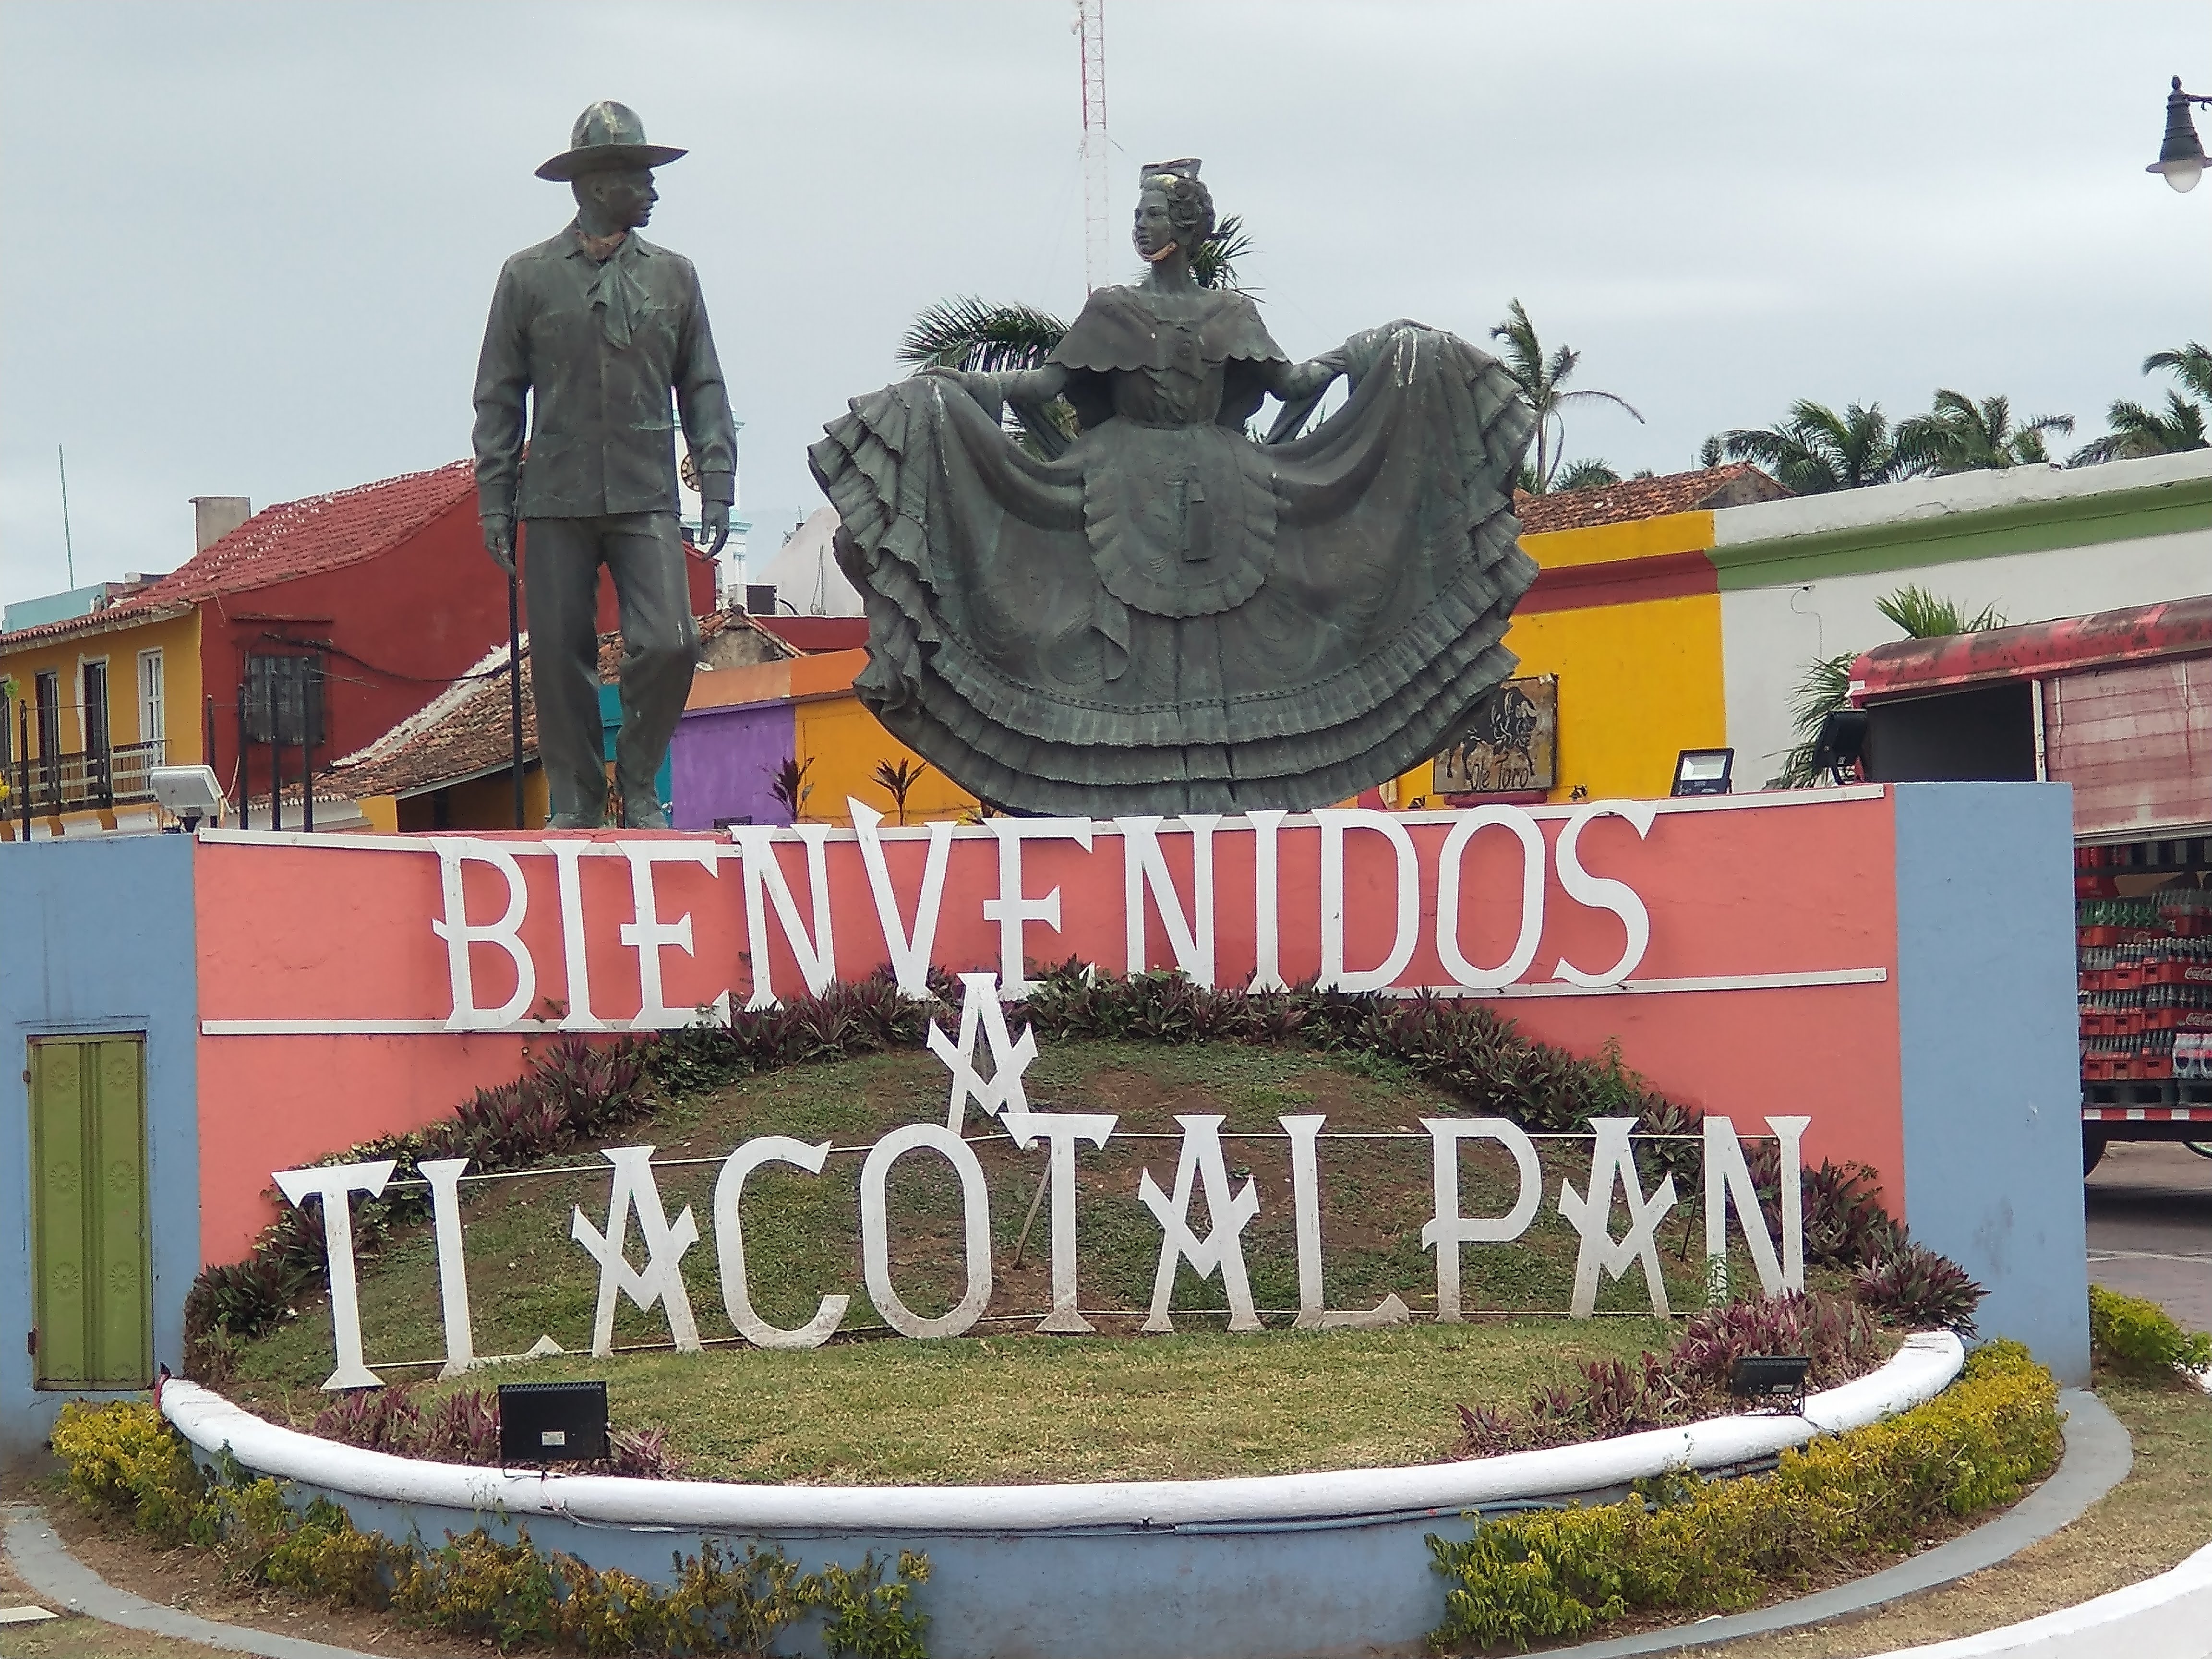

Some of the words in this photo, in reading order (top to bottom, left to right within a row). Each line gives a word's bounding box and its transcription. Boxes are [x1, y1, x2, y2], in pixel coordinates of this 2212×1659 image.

[428, 795, 1658, 1030] BIENVENIDOS
[927, 973, 1038, 1135] A
[270, 1112, 1812, 1392] TLACOTALPAN
